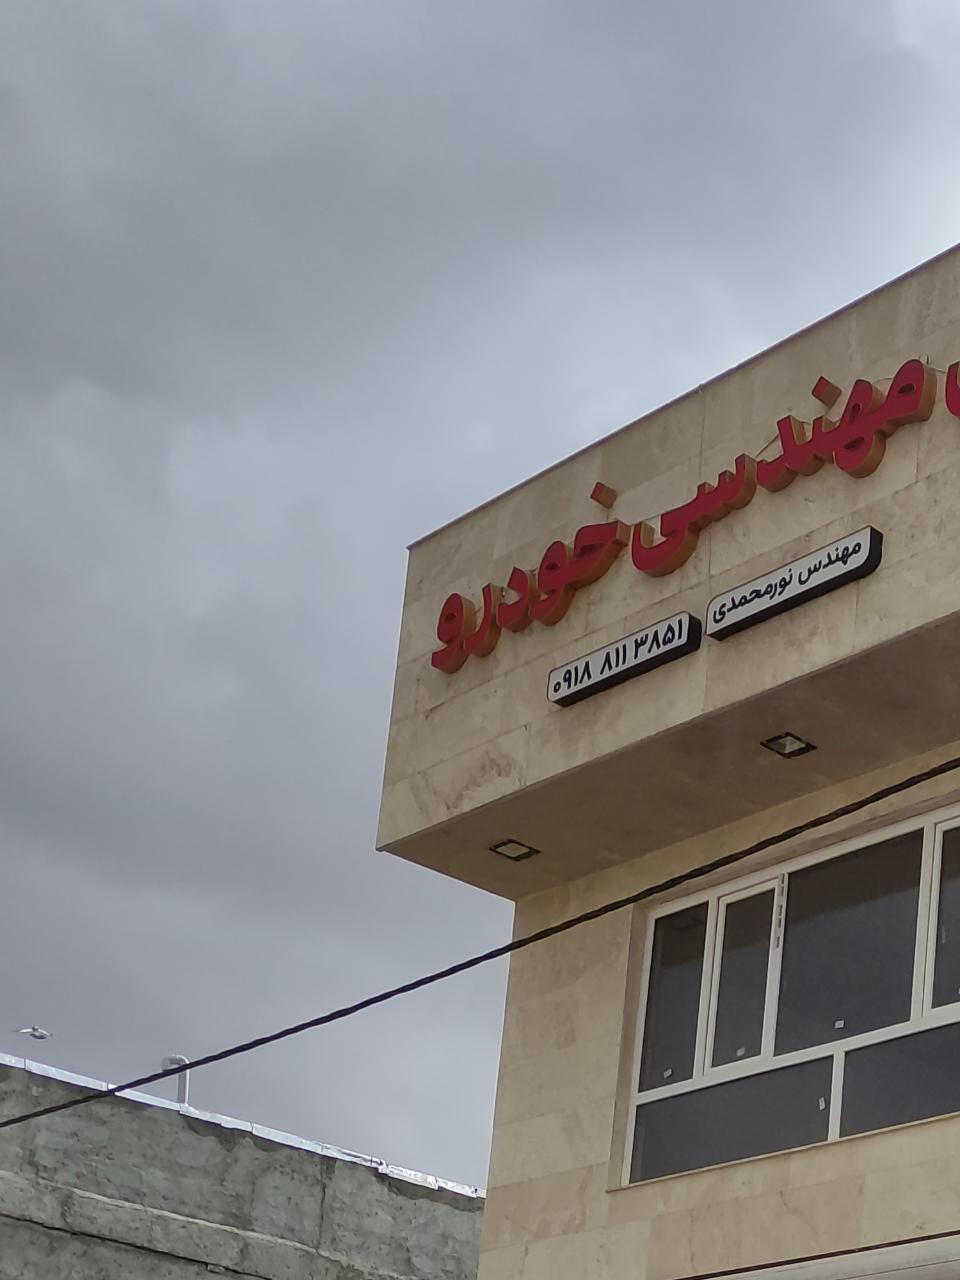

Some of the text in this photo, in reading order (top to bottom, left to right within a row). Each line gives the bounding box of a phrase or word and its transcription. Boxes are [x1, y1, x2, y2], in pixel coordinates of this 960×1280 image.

[632, 359, 937, 577] مهندسی
[431, 481, 633, 674] خودرو
[712, 540, 863, 624] مهندس نورمحمدی
[553, 617, 684, 695] ۰۹۱۸ ۸۱۱ ۳۸۵۱
